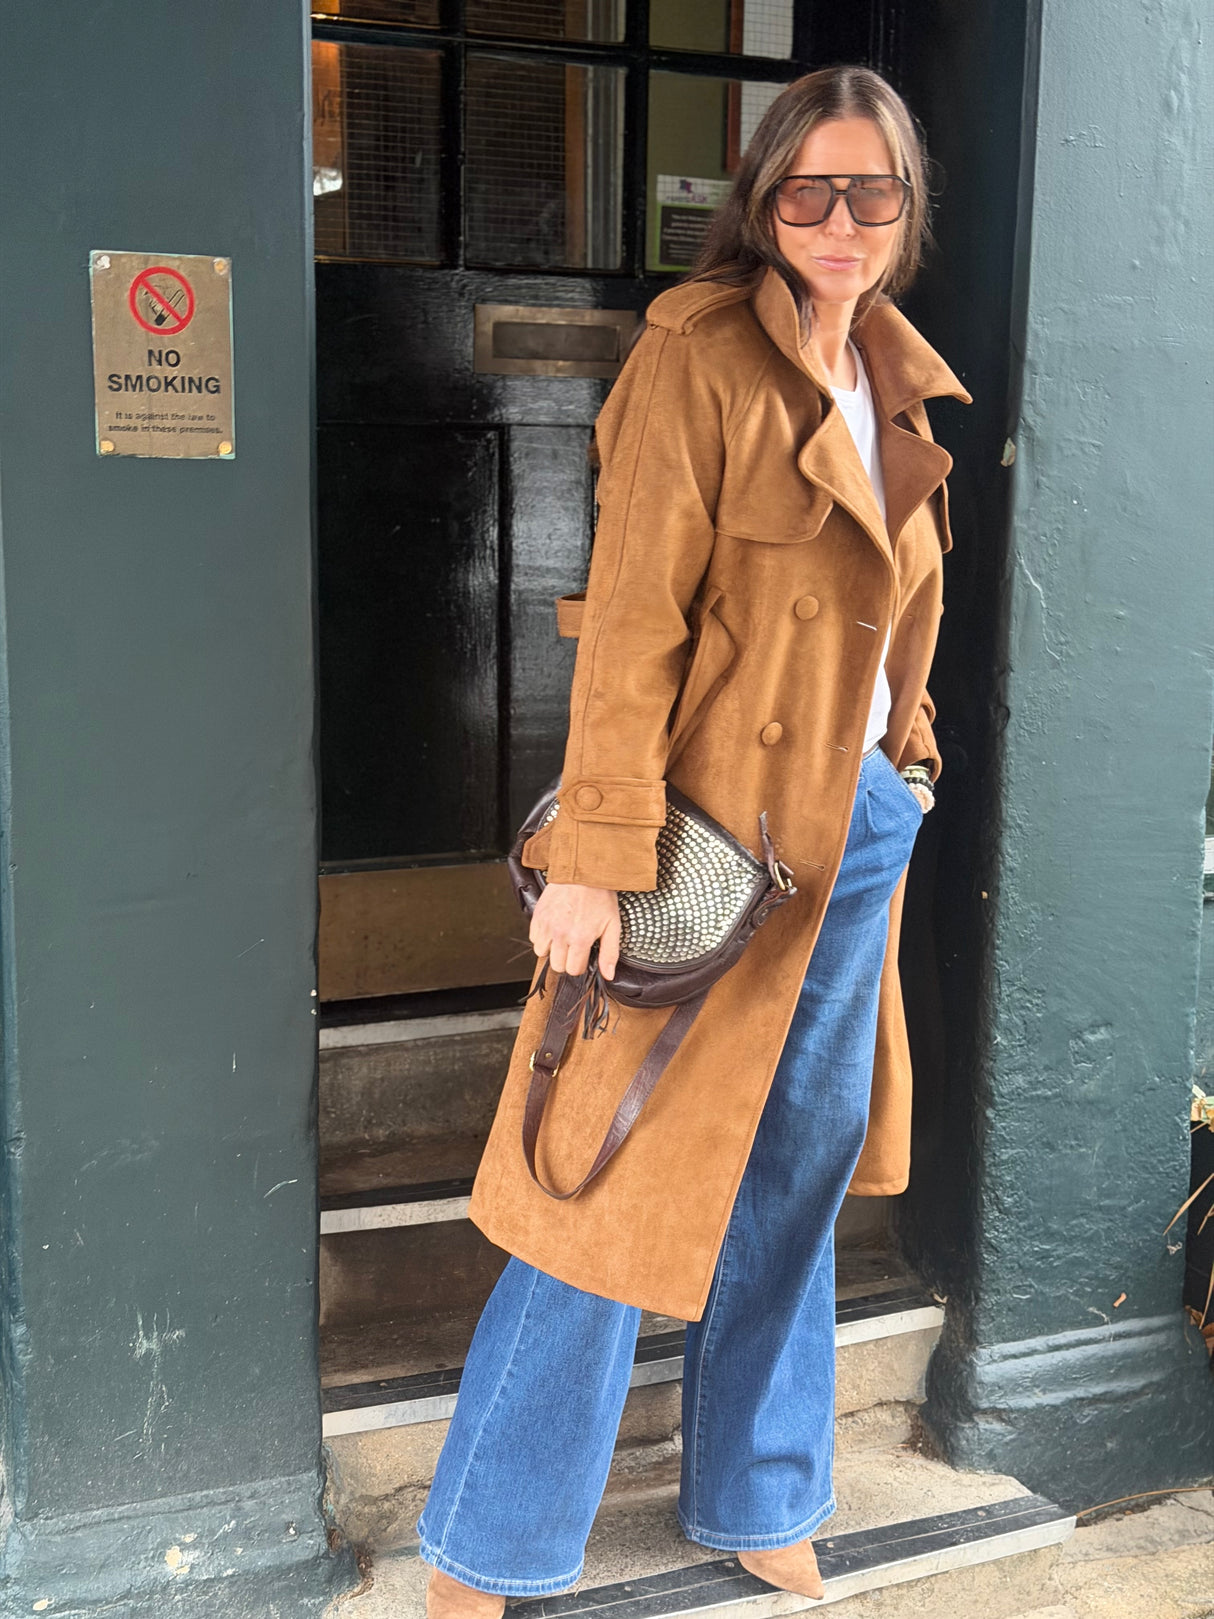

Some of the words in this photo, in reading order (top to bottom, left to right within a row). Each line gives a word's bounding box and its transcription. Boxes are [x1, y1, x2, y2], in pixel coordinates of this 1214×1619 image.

[147, 349, 181, 368] NO
[107, 373, 221, 394] SMOKING
[115, 410, 123, 420] It
[124, 412, 133, 420] is
[135, 412, 169, 422] against
[170, 412, 186, 421] the
[206, 413, 216, 421] to
[108, 424, 138, 432] smoke
[151, 425, 177, 433] these
